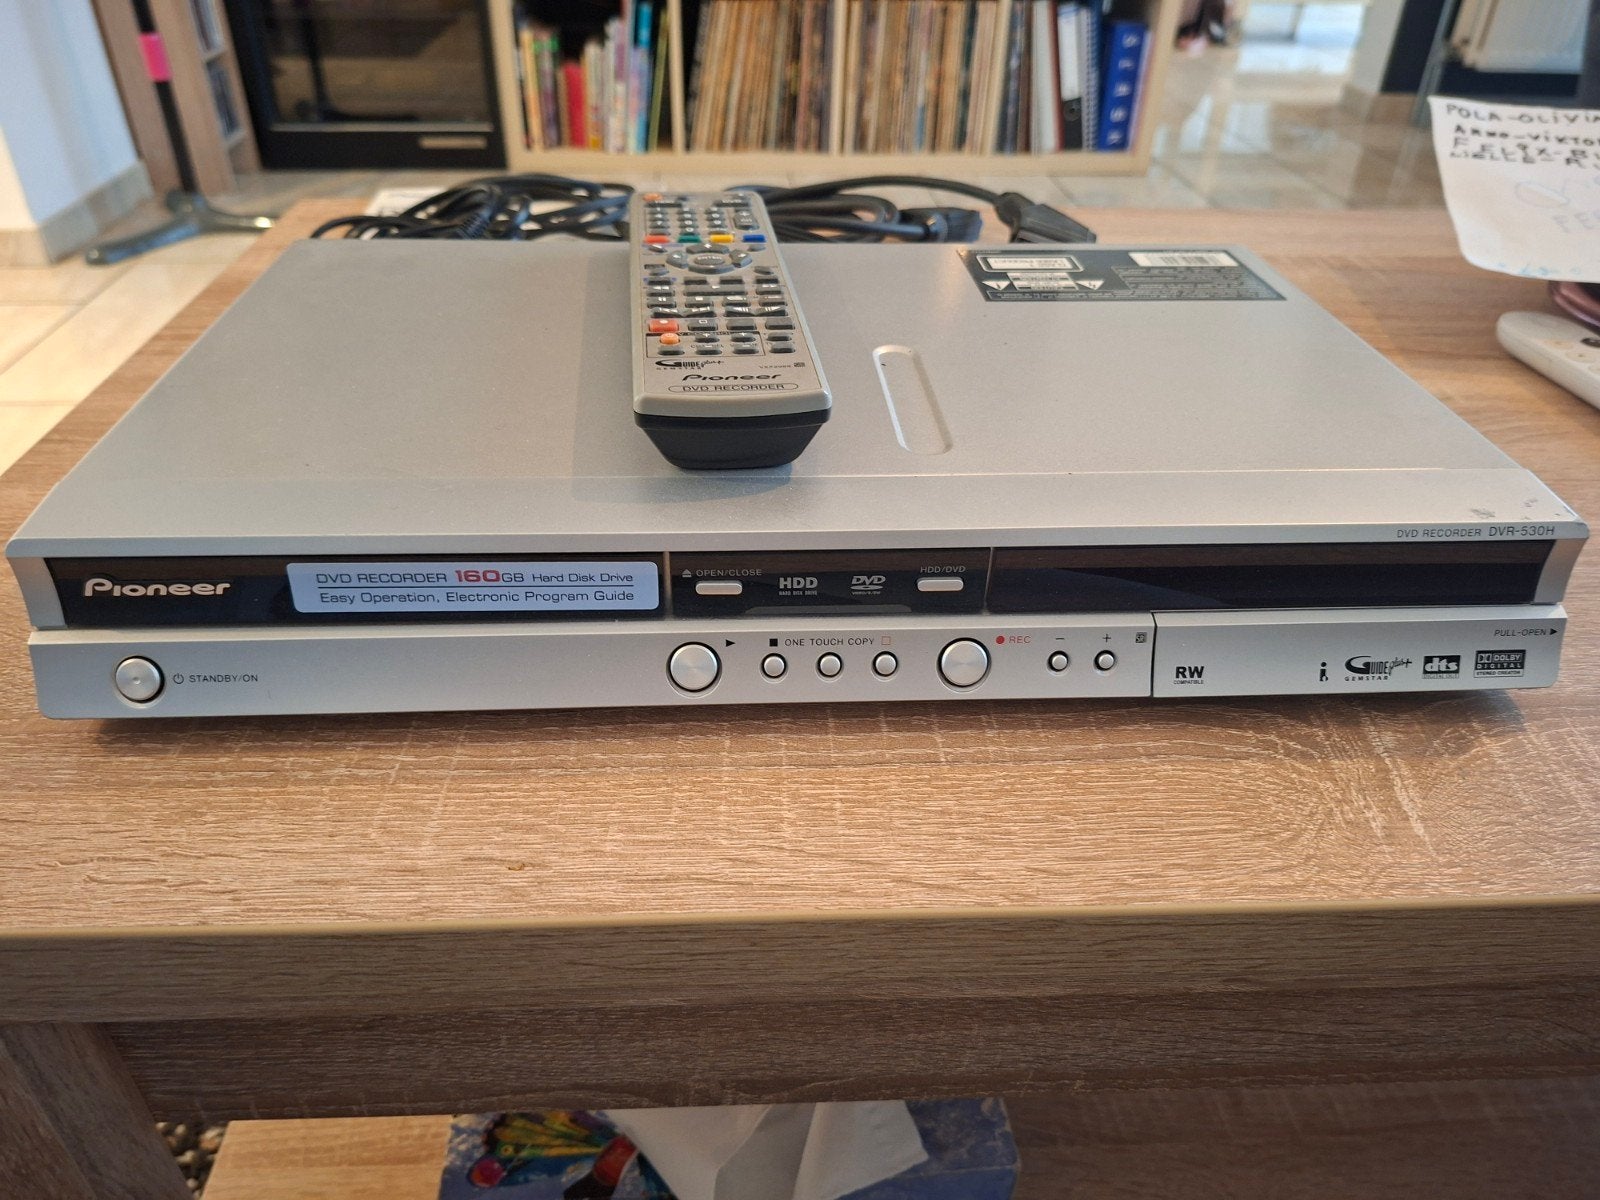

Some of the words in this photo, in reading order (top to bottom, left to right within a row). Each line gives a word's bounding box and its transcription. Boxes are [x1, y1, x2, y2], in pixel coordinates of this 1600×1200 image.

[682, 374, 782, 382] Pioneer
[1397, 529, 1419, 538] DVD
[1422, 528, 1482, 537] RECORDER
[1488, 526, 1556, 537] DVR-530H
[695, 568, 763, 577] OPEN/CLOSE
[920, 565, 966, 574] HDD/DVD
[316, 573, 352, 584] DVD
[357, 573, 448, 584] RECORDER
[532, 572, 565, 582] Hard
[568, 572, 596, 582] Disk
[600, 573, 634, 582] Drive
[779, 577, 819, 589] HDD
[851, 575, 886, 586] DVD
[84, 577, 232, 597] Pioneer
[320, 592, 356, 605] Easy
[360, 592, 441, 605] Operation,
[446, 591, 520, 603] Electronic
[525, 591, 593, 604] Program
[593, 590, 634, 602] Guide
[1494, 628, 1547, 637] PULL-OPEN
[784, 638, 805, 647] ONE
[810, 638, 844, 646] TOUCH
[848, 637, 875, 646] COPY
[1008, 635, 1032, 644] REC
[1494, 653, 1521, 662] DOLBY
[1424, 657, 1459, 672] dts
[1175, 666, 1205, 679] RW
[188, 674, 259, 683] STANDBY/ON
